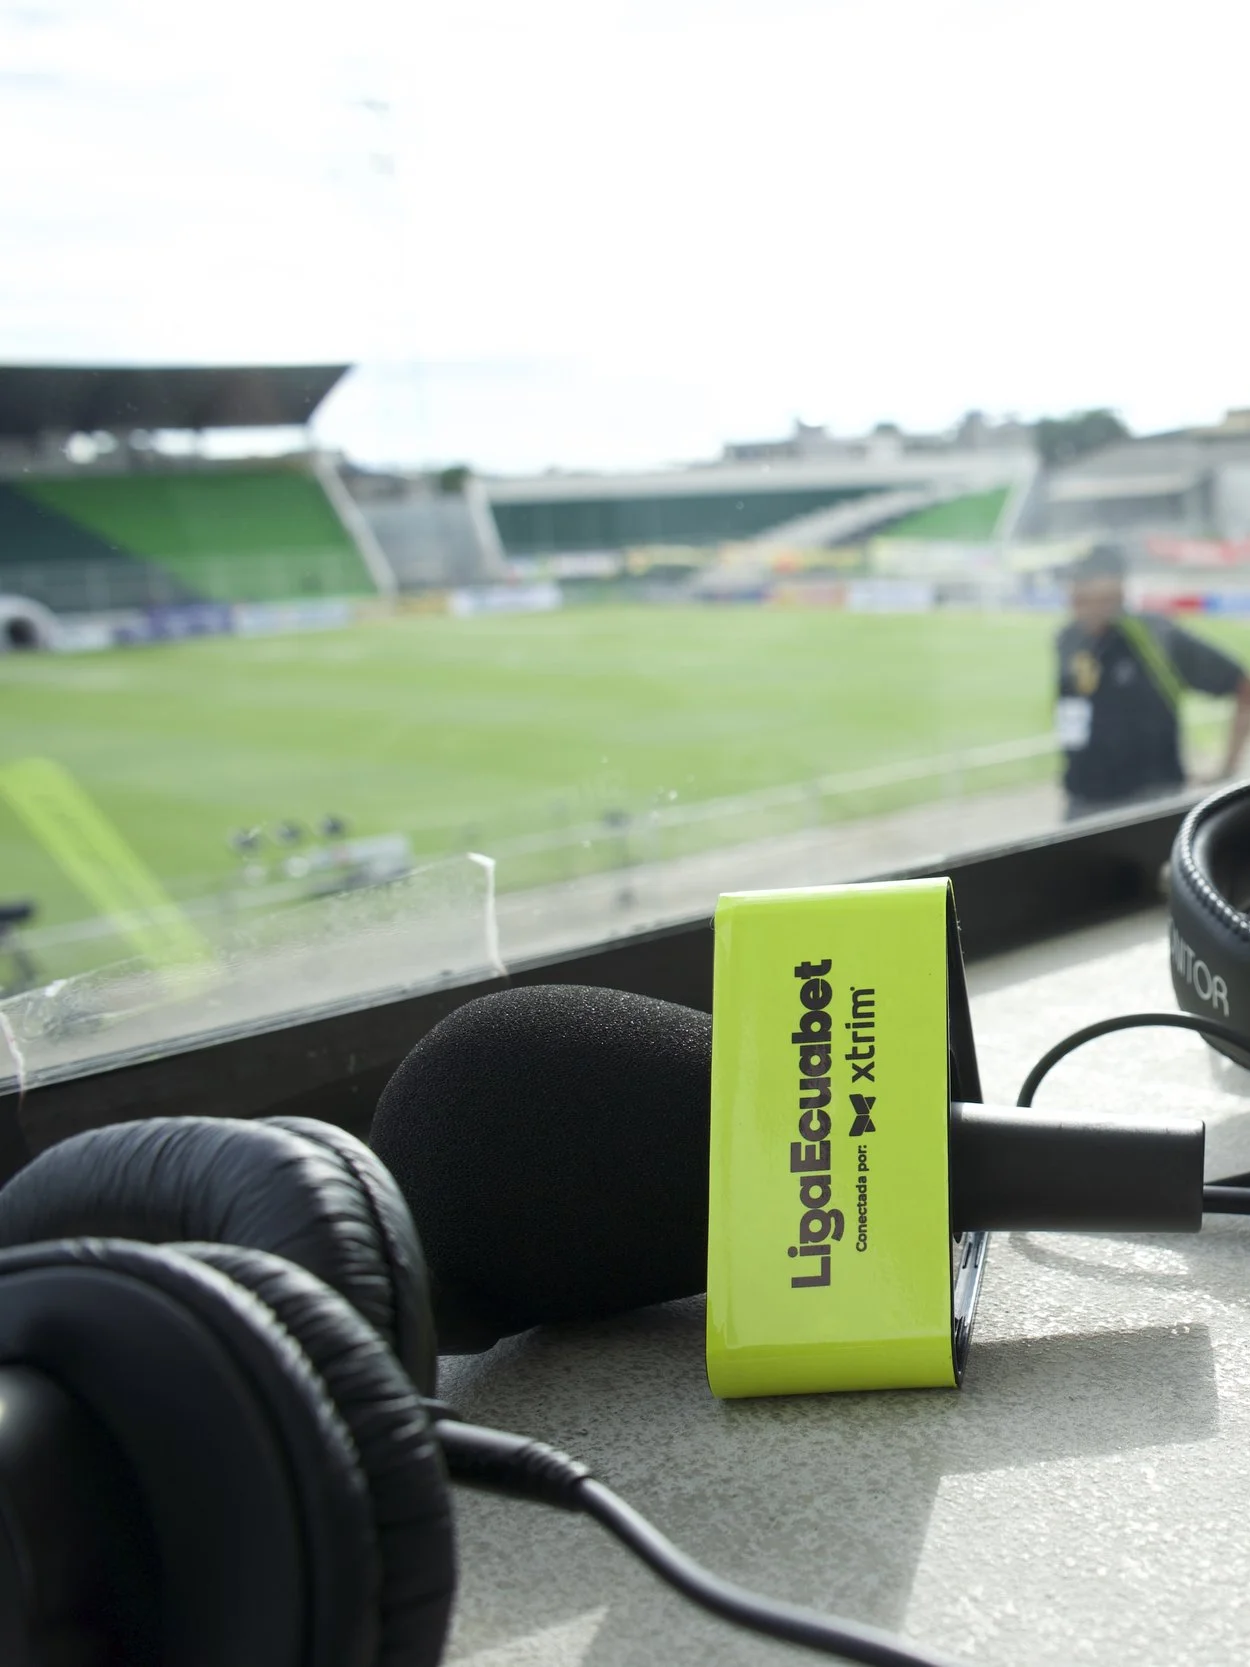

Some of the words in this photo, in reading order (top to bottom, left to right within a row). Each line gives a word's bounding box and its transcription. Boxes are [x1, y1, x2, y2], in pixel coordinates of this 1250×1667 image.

[845, 986, 876, 1083] xtrim
[787, 958, 845, 1289] LigaEcuabet
[857, 1144, 870, 1173] por:
[855, 1175, 867, 1253] Conectada
